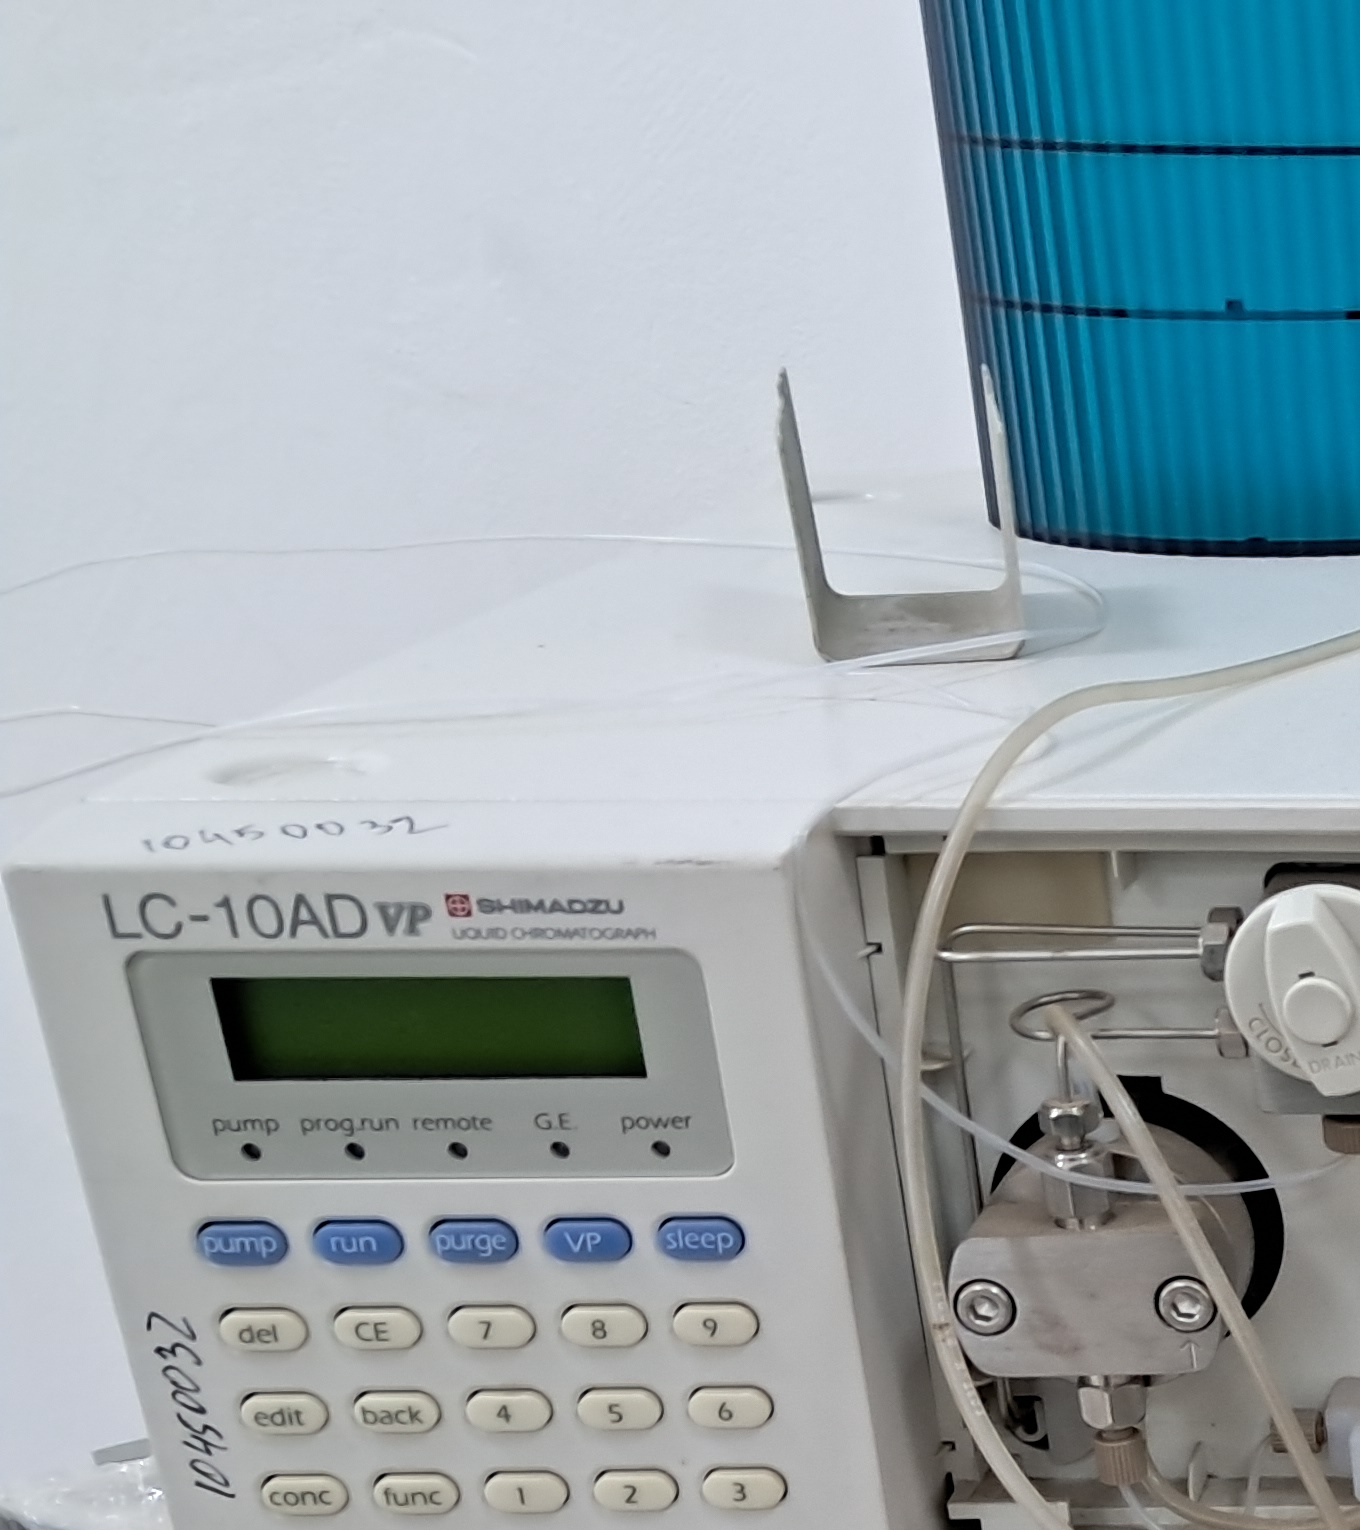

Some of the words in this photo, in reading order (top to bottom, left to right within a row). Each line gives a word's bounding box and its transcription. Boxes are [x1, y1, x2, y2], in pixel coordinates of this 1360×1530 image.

[102, 894, 369, 941] LC-10AD
[373, 901, 433, 938] VP
[476, 898, 625, 915] SHIMADZU
[511, 926, 657, 940] CHROMATOGRAPH
[213, 1116, 279, 1137] pump
[300, 1114, 400, 1138] prog.run
[412, 1114, 493, 1133] remote
[534, 1112, 577, 1132] G.E.
[621, 1112, 692, 1136] power
[203, 1232, 278, 1260] pump
[330, 1231, 378, 1254] run
[435, 1229, 508, 1258] purge
[563, 1230, 602, 1254] VP
[664, 1227, 734, 1256] sleep
[238, 1321, 280, 1344] del
[354, 1320, 390, 1343] CE
[477, 1319, 493, 1342] 7
[590, 1318, 608, 1341] 8
[702, 1317, 720, 1339] 9
[253, 1404, 306, 1426] edit
[360, 1404, 424, 1426] back
[495, 1402, 513, 1424] 4
[607, 1402, 624, 1423] 5
[717, 1401, 735, 1422] 6
[268, 1488, 333, 1508] conc
[382, 1486, 443, 1508] func
[515, 1486, 527, 1506] 1
[623, 1484, 639, 1505] 2
[731, 1481, 748, 1502] 3
